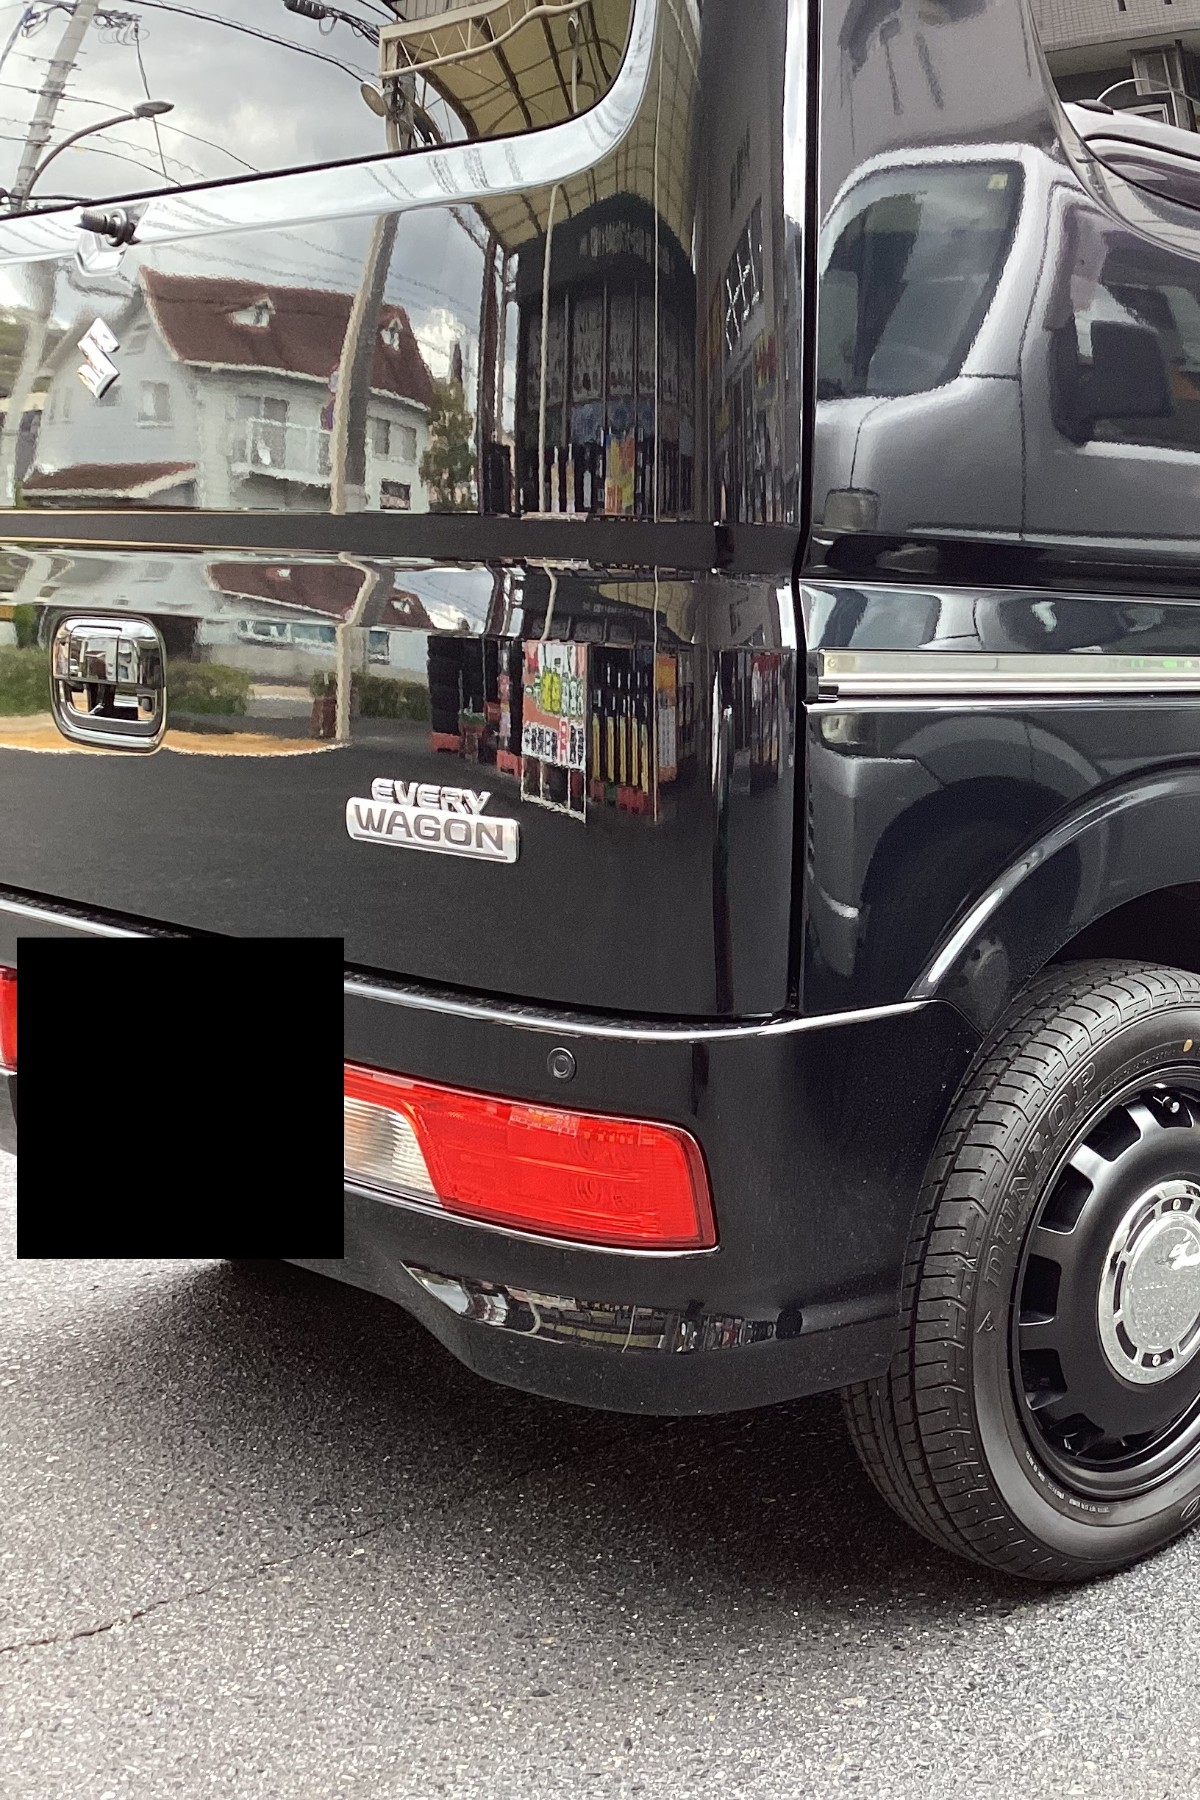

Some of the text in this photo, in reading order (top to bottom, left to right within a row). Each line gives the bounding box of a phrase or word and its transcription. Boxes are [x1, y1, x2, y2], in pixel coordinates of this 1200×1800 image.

[371, 777, 491, 815] EVERY
[354, 804, 504, 852] WAGON
[984, 1061, 1096, 1288] DUNLOP
